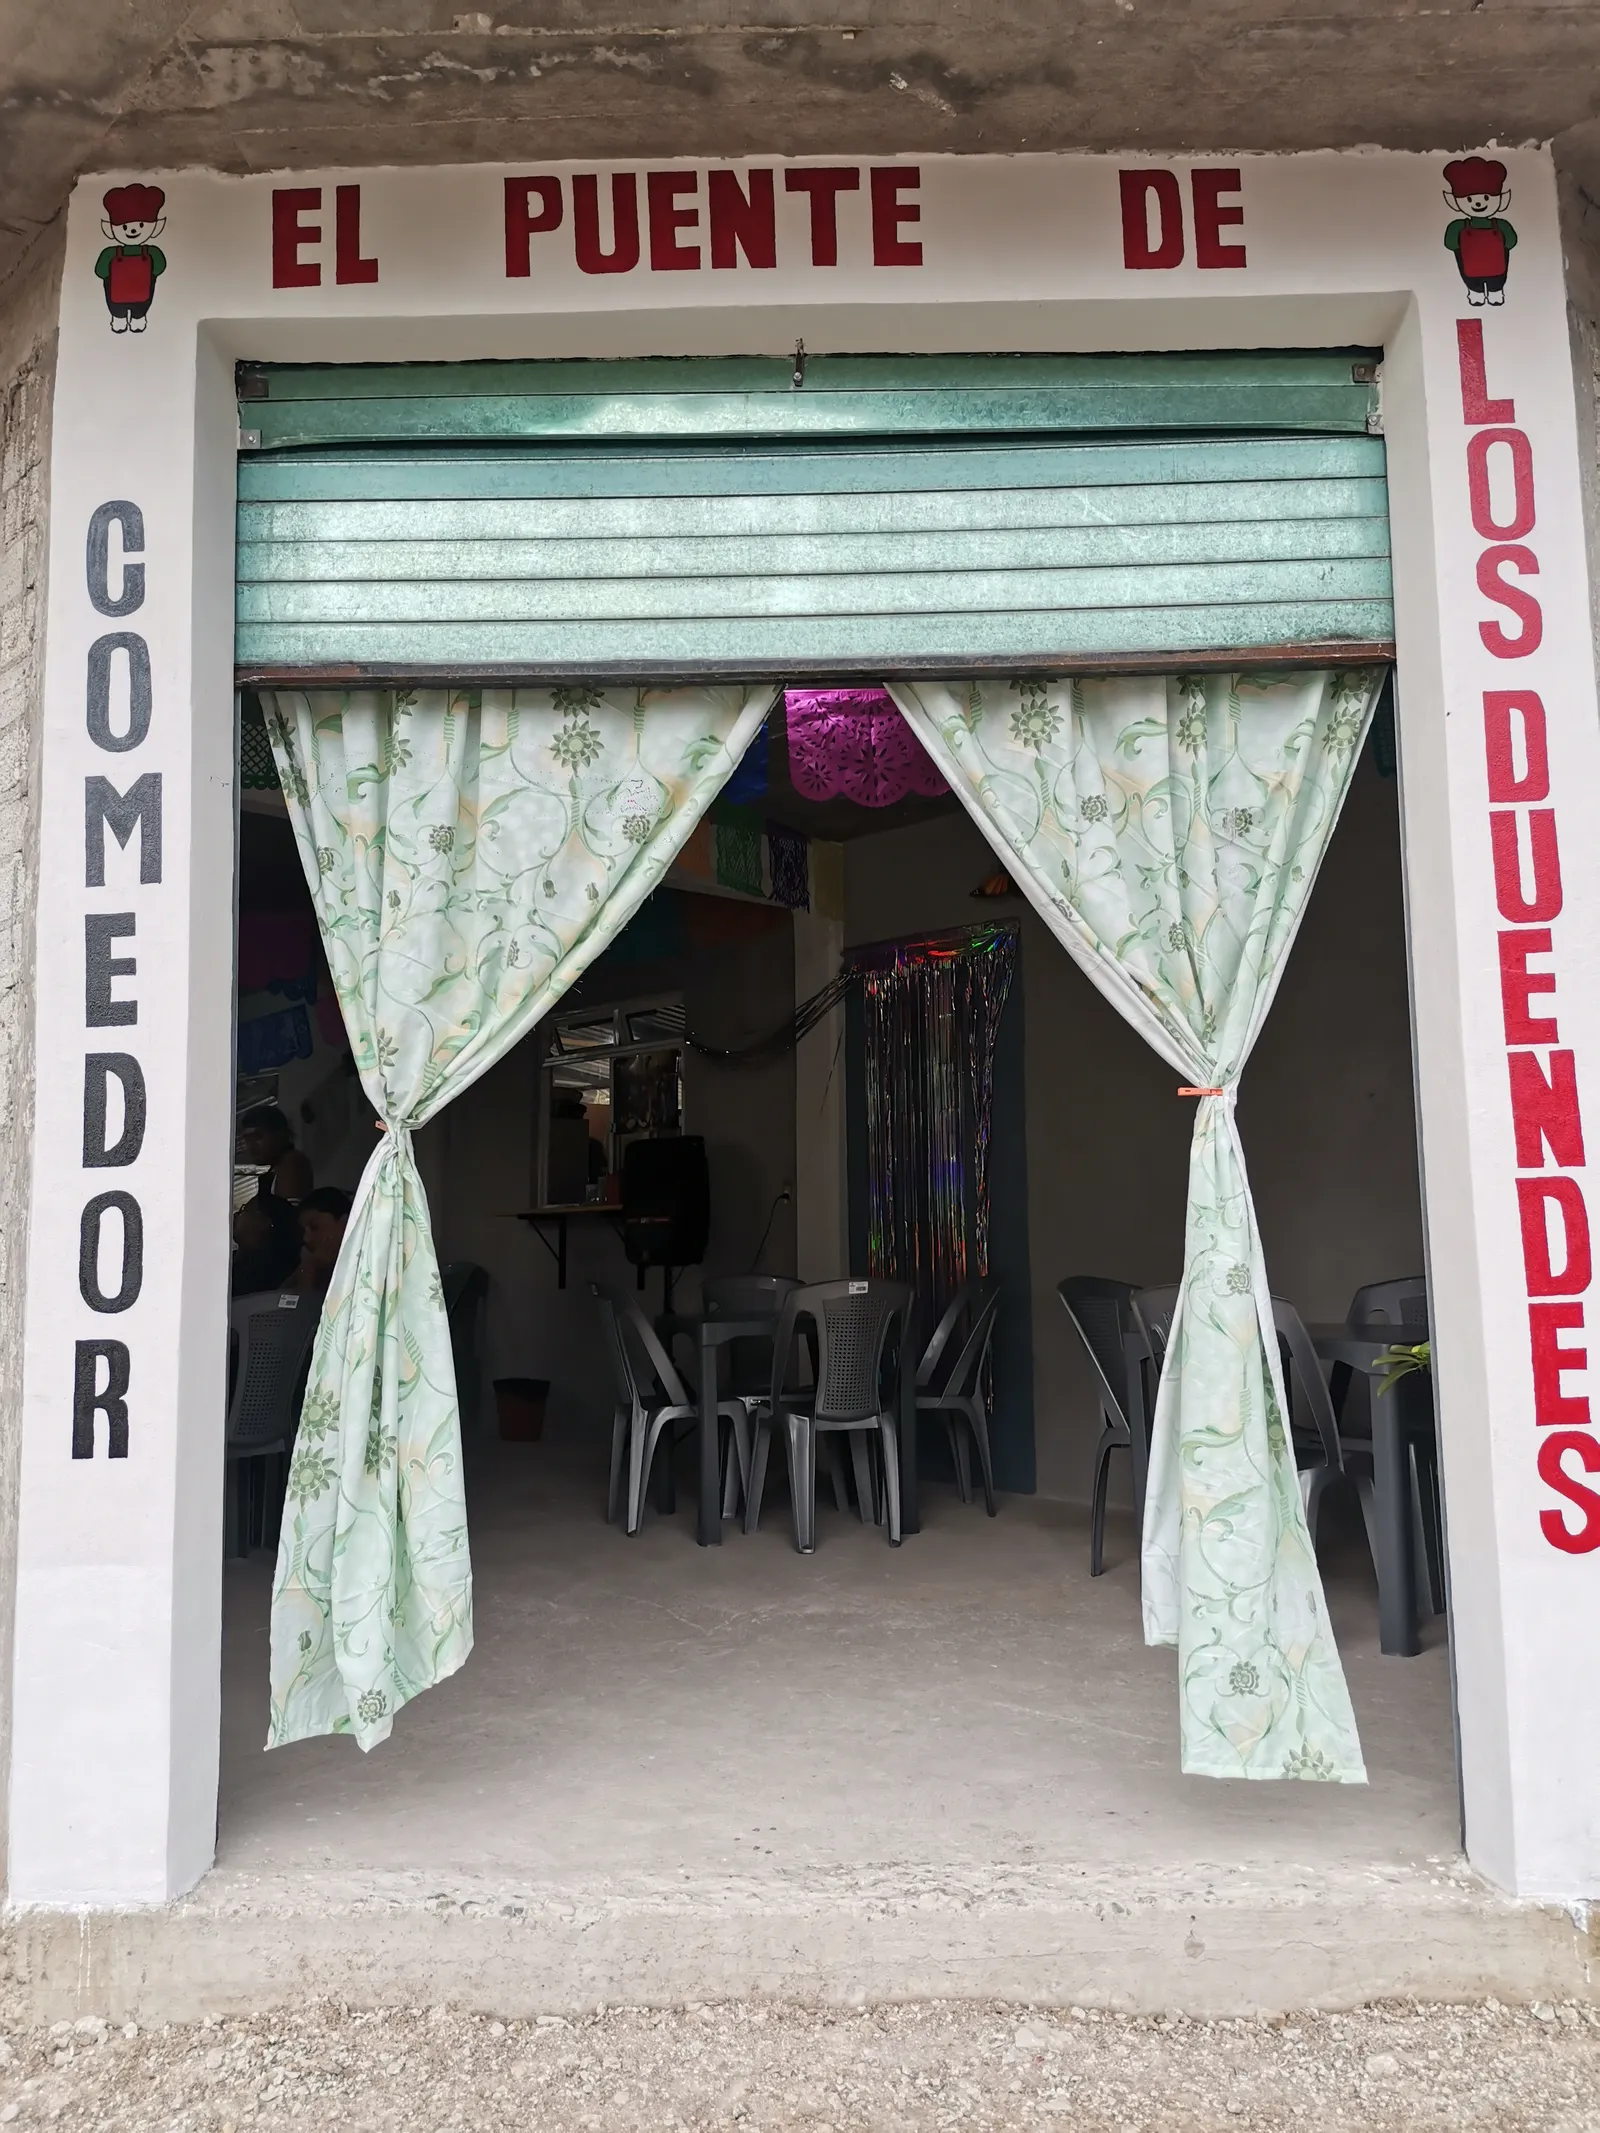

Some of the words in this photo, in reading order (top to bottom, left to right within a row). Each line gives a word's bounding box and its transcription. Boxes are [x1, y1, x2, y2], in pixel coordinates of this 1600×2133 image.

[272, 184, 378, 288] EL
[504, 167, 923, 278] PUENTE
[1119, 169, 1246, 269] DE
[1456, 318, 1543, 660] LOS
[71, 499, 163, 1460] COMEDOR
[1481, 689, 1600, 1556] DUENDES
